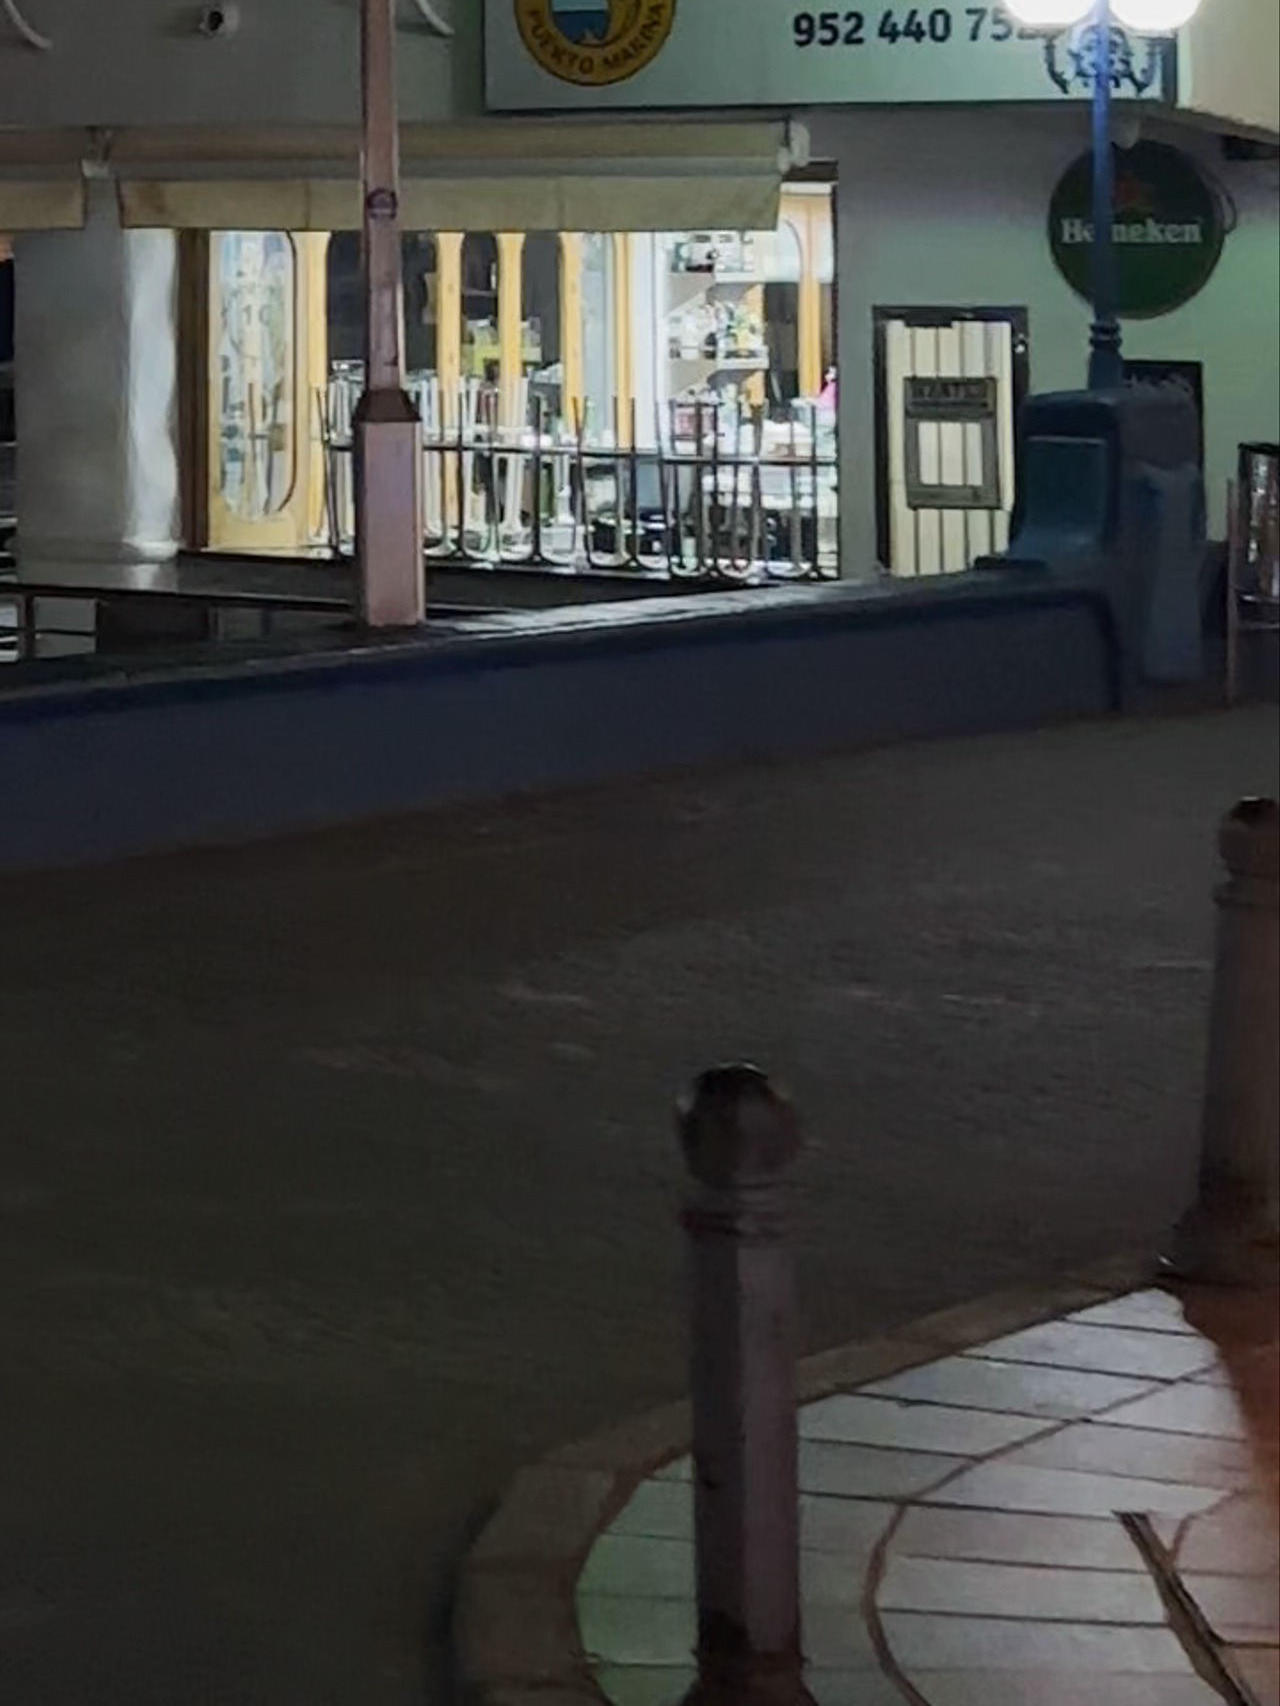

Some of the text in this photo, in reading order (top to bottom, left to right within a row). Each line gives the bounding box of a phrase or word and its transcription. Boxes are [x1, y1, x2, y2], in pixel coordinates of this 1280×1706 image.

[528, 3, 667, 75] PUERTO MARINA
[792, 11, 865, 47] 952
[877, 7, 952, 44] 440
[1060, 217, 1203, 244] Heneken
